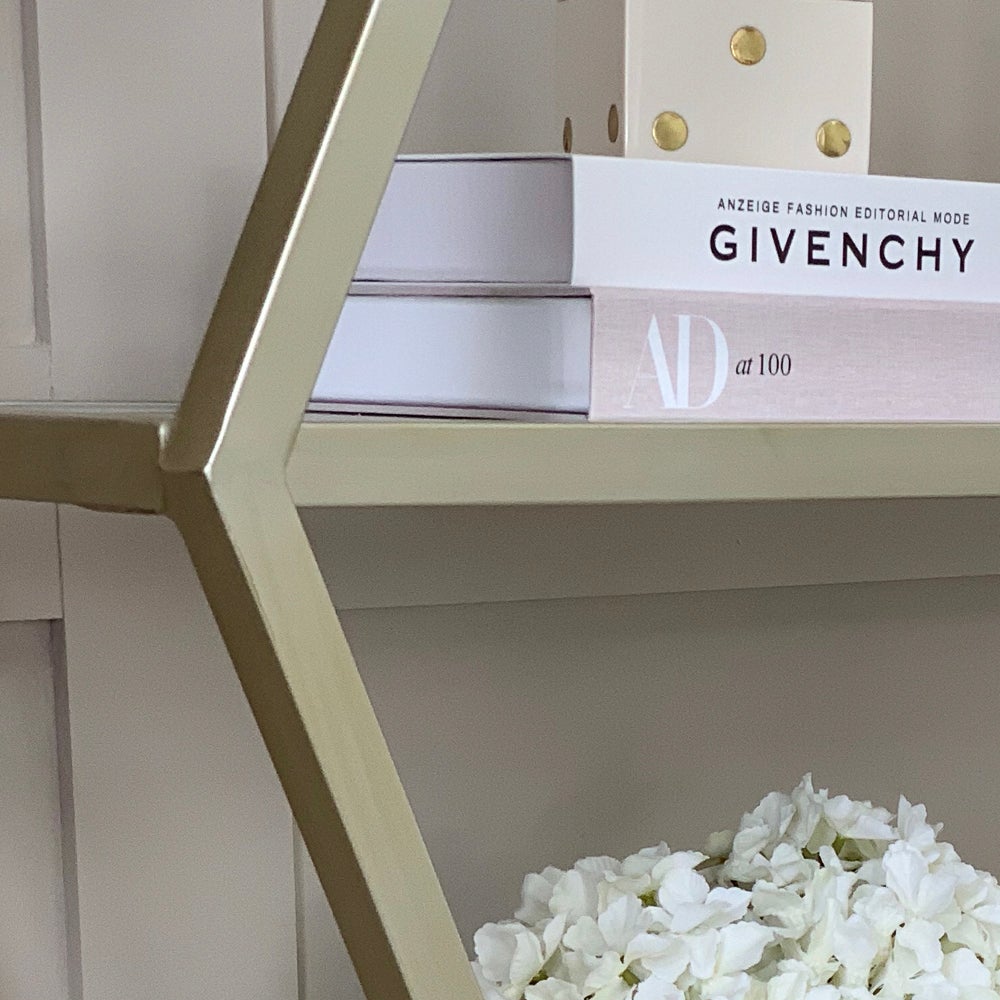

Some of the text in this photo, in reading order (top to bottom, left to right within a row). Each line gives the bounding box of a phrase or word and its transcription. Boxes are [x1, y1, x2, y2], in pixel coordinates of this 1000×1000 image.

[717, 198, 971, 225] ANZEIGE FASHION EDITORIAL MODE
[709, 224, 975, 273] GIVENCHY
[623, 313, 792, 410] AD at 100
